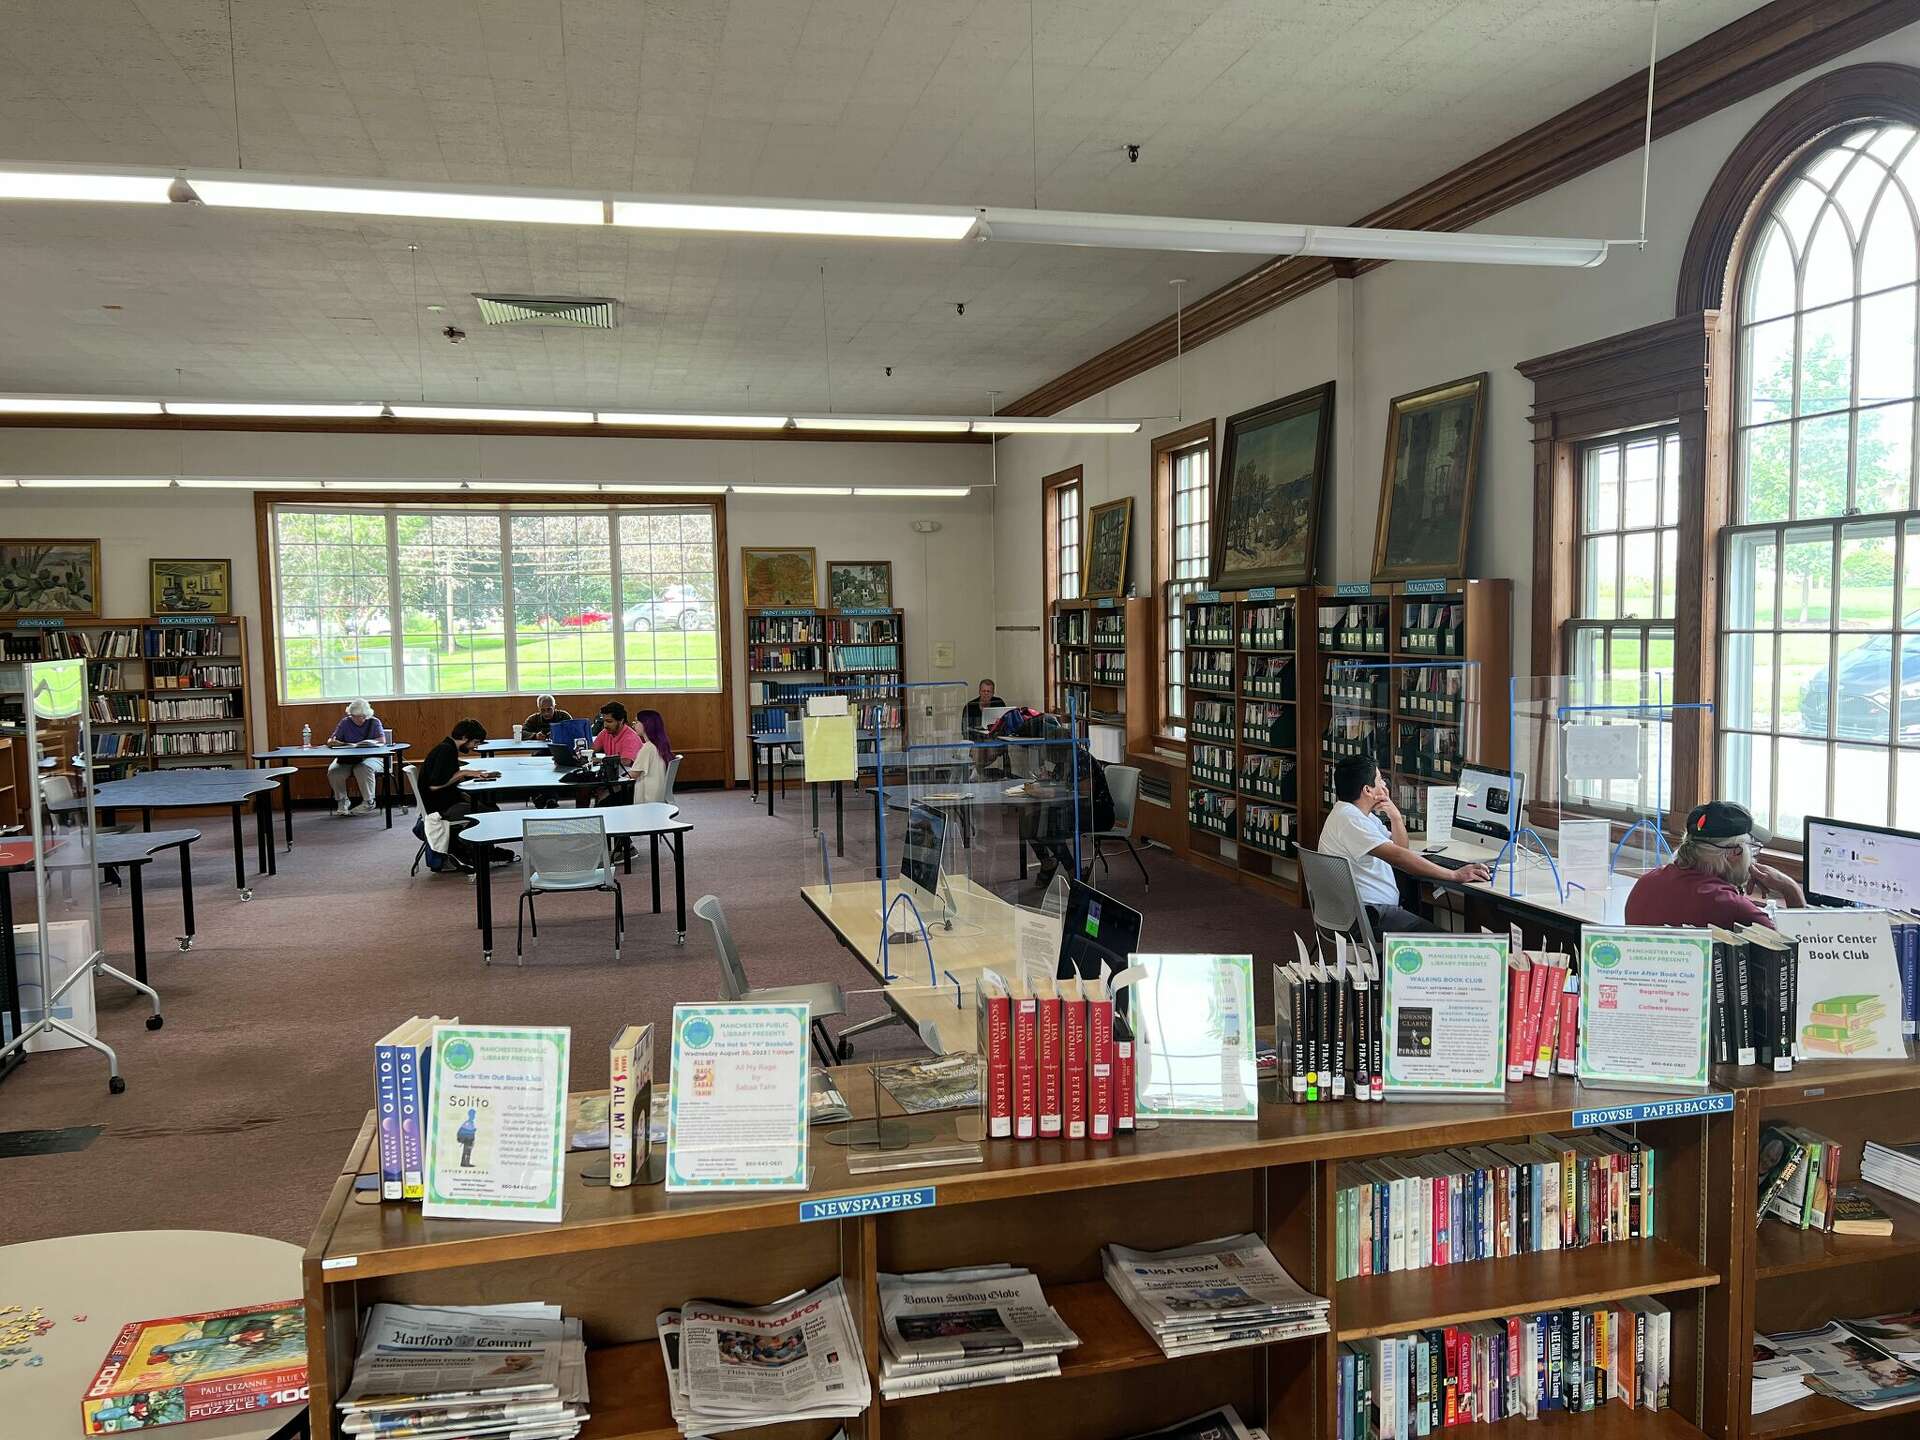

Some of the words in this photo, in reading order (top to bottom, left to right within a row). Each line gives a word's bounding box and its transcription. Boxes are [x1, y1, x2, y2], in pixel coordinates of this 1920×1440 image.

[1339, 585, 1369, 594] MAGAZINES
[1408, 582, 1445, 592] MAGAZINES
[19, 619, 62, 627] GENEALOGY
[1795, 933, 1834, 944] Senior
[1837, 934, 1877, 944] Center
[1808, 950, 1840, 960] Book
[1842, 950, 1870, 960] Club
[1597, 968, 1623, 976] Happily
[1639, 989, 1675, 997] Regretting
[992, 1004, 1000, 1060] SCOTTOLINE
[1043, 1005, 1051, 1061] SCOTTOLINE
[1050, 1023, 1058, 1042] LISA
[1067, 1006, 1076, 1062] SCOTTOLINE
[1094, 1007, 1102, 1063] SCOTTOLINE
[1336, 1041, 1344, 1077] PIRANES
[1398, 1047, 1431, 1056] PIRANESI
[454, 1073, 475, 1081] Check
[758, 1064, 777, 1072] Rage
[381, 1051, 394, 1114] SOLITO
[400, 1052, 414, 1115] SOLITO
[448, 1095, 490, 1108] Solito
[614, 1085, 625, 1107] ALL
[996, 1073, 1005, 1118] ETERNA
[1022, 1074, 1031, 1117] ETERNA
[1071, 1076, 1081, 1120] ETERNA
[1098, 1076, 1108, 1113] ETERN
[1582, 1108, 1633, 1125] BROWSE
[1642, 1098, 1725, 1118] PAPERBACKS
[614, 1112, 625, 1131] MY
[383, 1133, 391, 1168] ZAMORA
[403, 1135, 411, 1169] ZAMORA
[1630, 1164, 1639, 1189] SANDFORD
[813, 1192, 923, 1217] NEWSPAPERS
[1148, 1265, 1176, 1275] USA
[1178, 1263, 1219, 1273] TODAY
[904, 1293, 944, 1305] Boston
[945, 1292, 987, 1305] Sunday
[988, 1288, 1022, 1300] Globe
[686, 1311, 755, 1327] Journal
[757, 1300, 822, 1328] Inquirer
[1572, 1311, 1580, 1331] BRAD
[111, 1322, 142, 1357] PUZZLE
[392, 1330, 454, 1348] Hartford
[476, 1337, 532, 1349] Courant
[1551, 1331, 1561, 1343] LEE
[1572, 1331, 1580, 1350] THOR
[1383, 1343, 1392, 1360] JOHN
[1551, 1343, 1561, 1361] CHILD
[1595, 1347, 1603, 1366] COBEN
[88, 1361, 121, 1397] 1000
[200, 1384, 224, 1396] PAUL
[225, 1378, 269, 1392] CEZANNE
[276, 1373, 299, 1383] BLUE
[1383, 1360, 1392, 1392] CONNOLLY
[1552, 1372, 1560, 1382] The
[270, 1386, 309, 1405] 100
[1552, 1382, 1561, 1399] Enemy
[188, 1400, 256, 1418] PUZZLE
